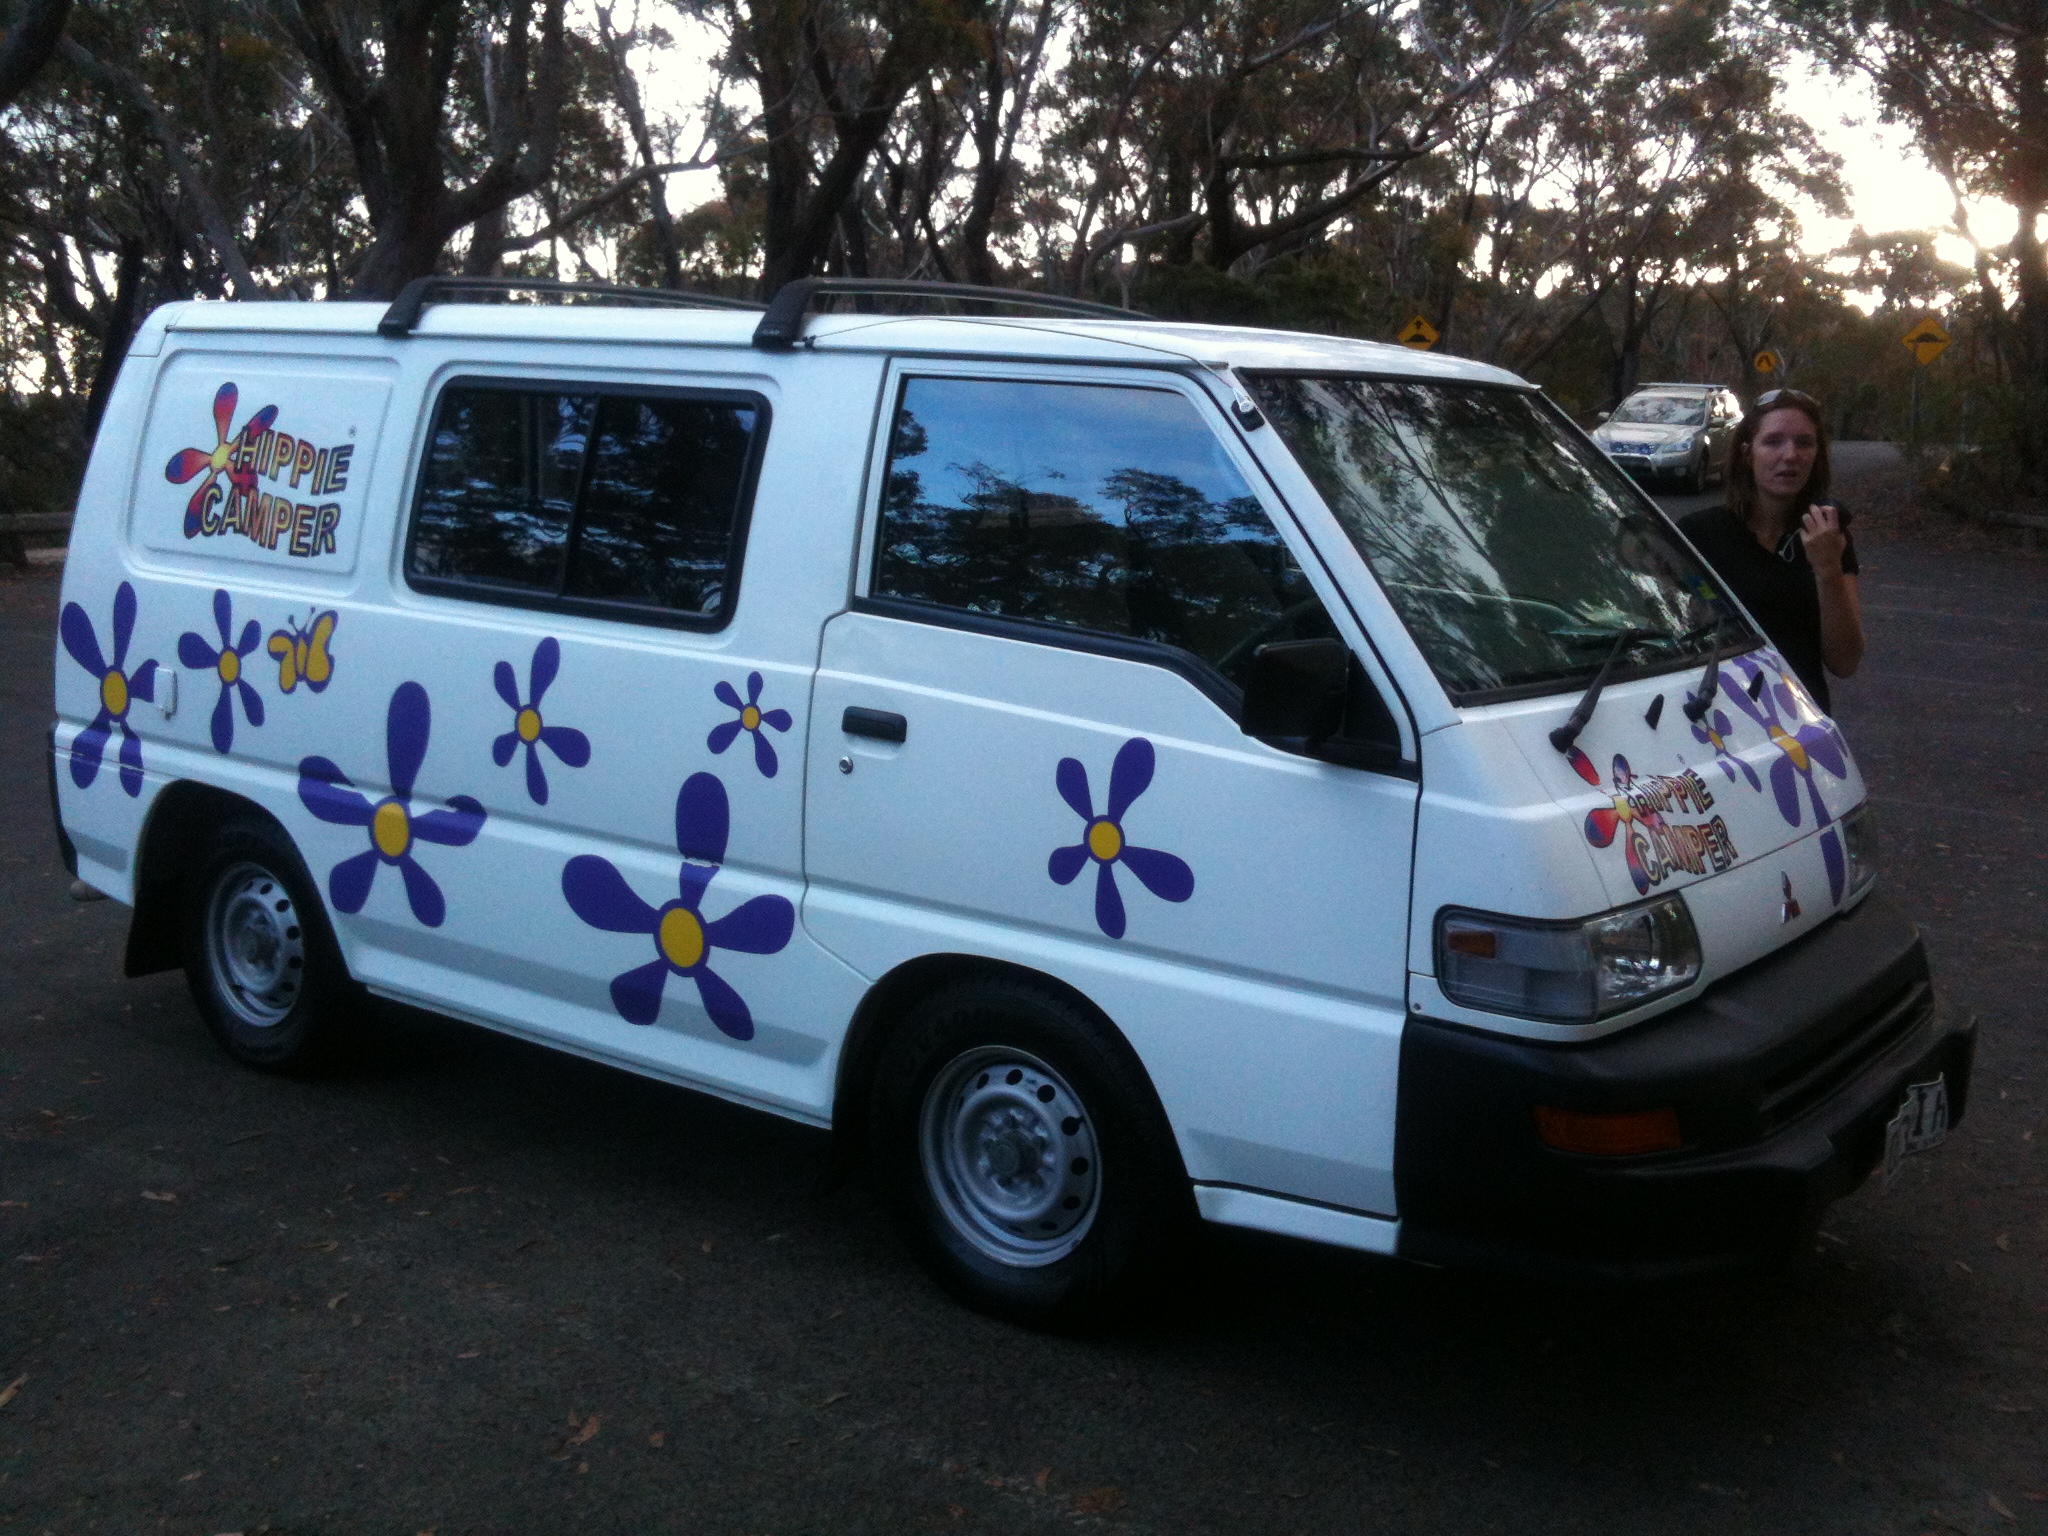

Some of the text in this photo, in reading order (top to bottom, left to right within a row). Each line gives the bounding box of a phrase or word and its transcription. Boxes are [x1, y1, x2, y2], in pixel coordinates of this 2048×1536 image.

[233, 425, 355, 496] HIPPIE
[201, 483, 341, 558] CAMPER
[1618, 767, 1715, 817] HIPPIE
[1631, 814, 1739, 887] CAMPER
